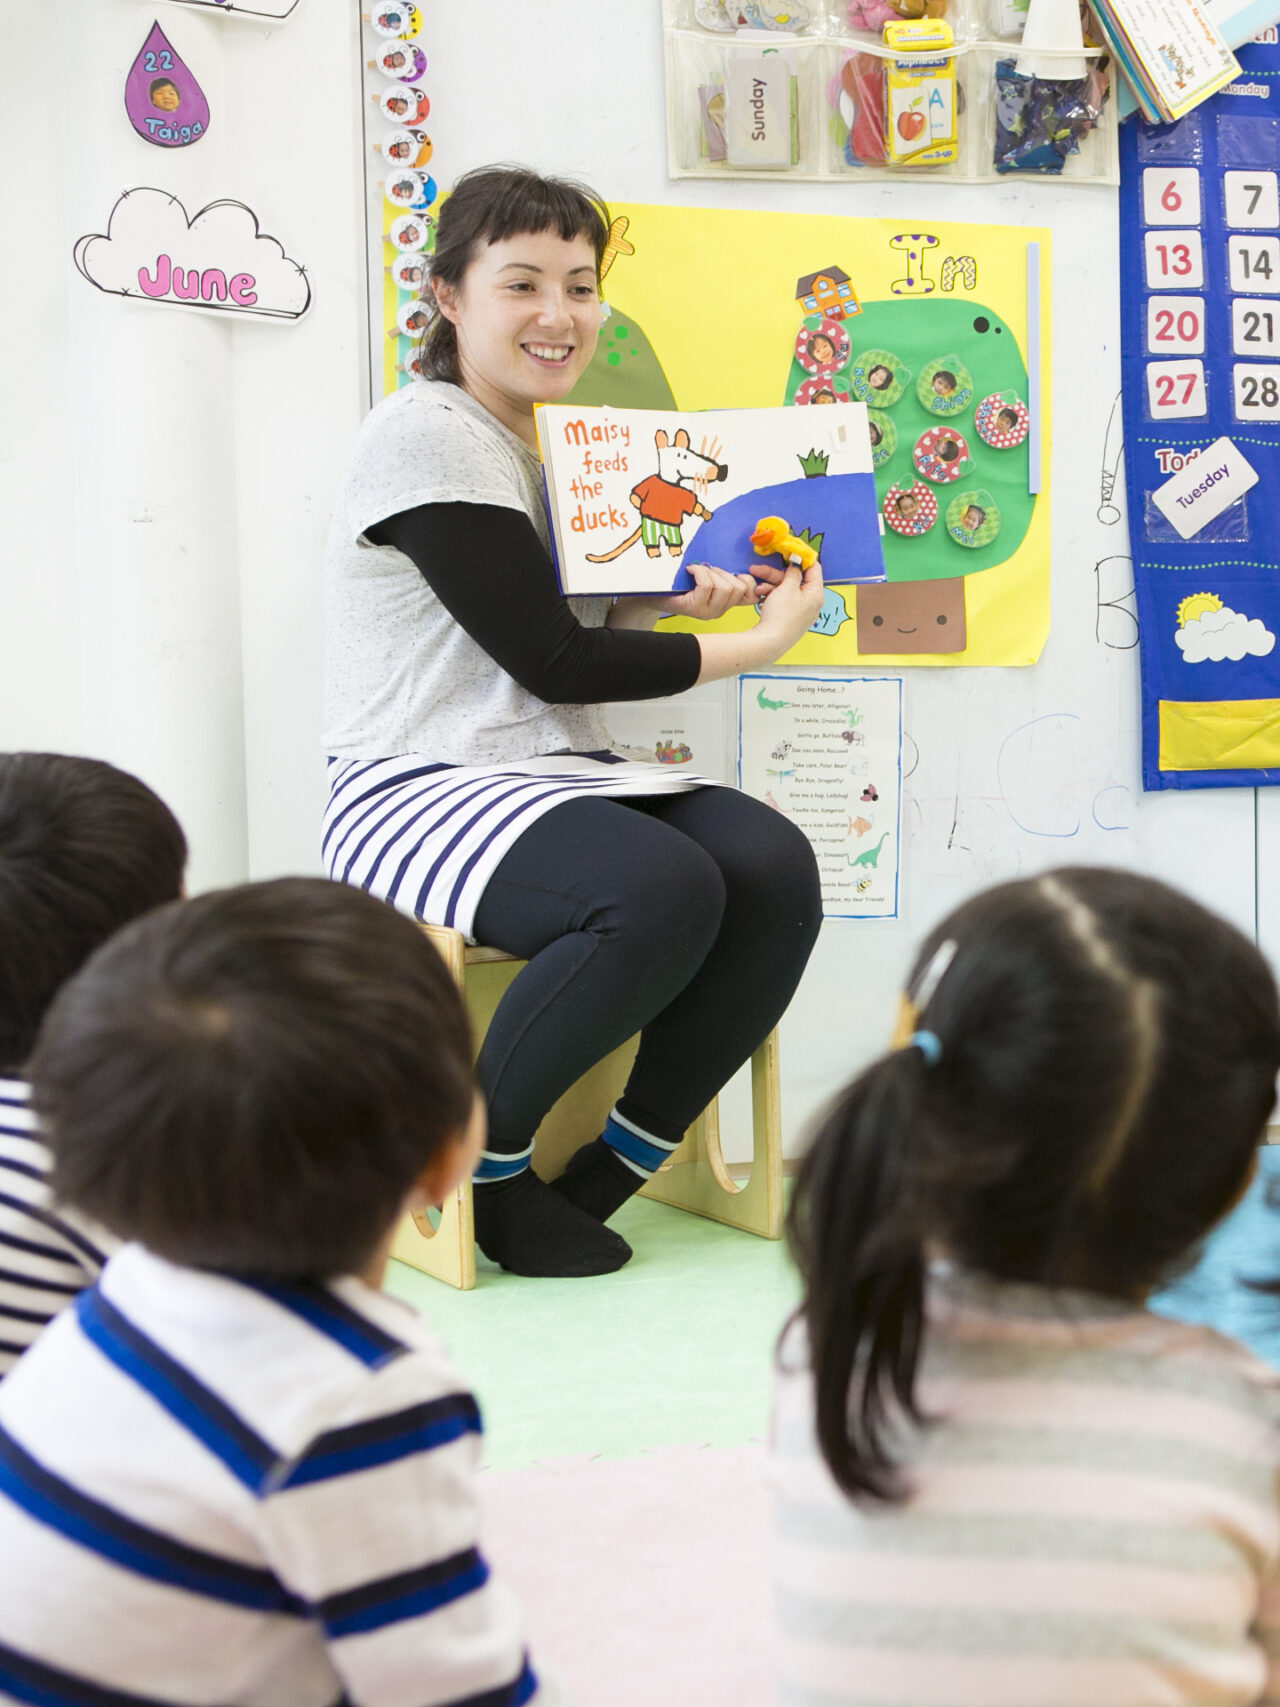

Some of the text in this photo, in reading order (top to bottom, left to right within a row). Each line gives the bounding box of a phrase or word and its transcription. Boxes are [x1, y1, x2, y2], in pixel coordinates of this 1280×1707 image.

[144, 50, 174, 72] 22
[929, 87, 945, 109] A
[1220, 83, 1268, 98] Monday
[749, 77, 768, 142] Sunday
[144, 117, 203, 144] Taiga
[1161, 181, 1182, 211] 6
[1243, 185, 1262, 214] 7
[889, 234, 977, 295] In
[1155, 245, 1192, 275] 13
[1239, 249, 1272, 279] 14
[137, 254, 258, 306] June
[1155, 310, 1198, 342] 20
[1243, 311, 1273, 342] 21
[931, 388, 971, 412] Shion
[1155, 373, 1197, 406] 27
[1241, 377, 1279, 407] 28
[564, 418, 630, 447] Maisy
[582, 450, 628, 474] feeds
[569, 474, 603, 501] the
[1176, 464, 1229, 508] Tuesday
[570, 503, 628, 533] ducks
[797, 686, 815, 694] Going
